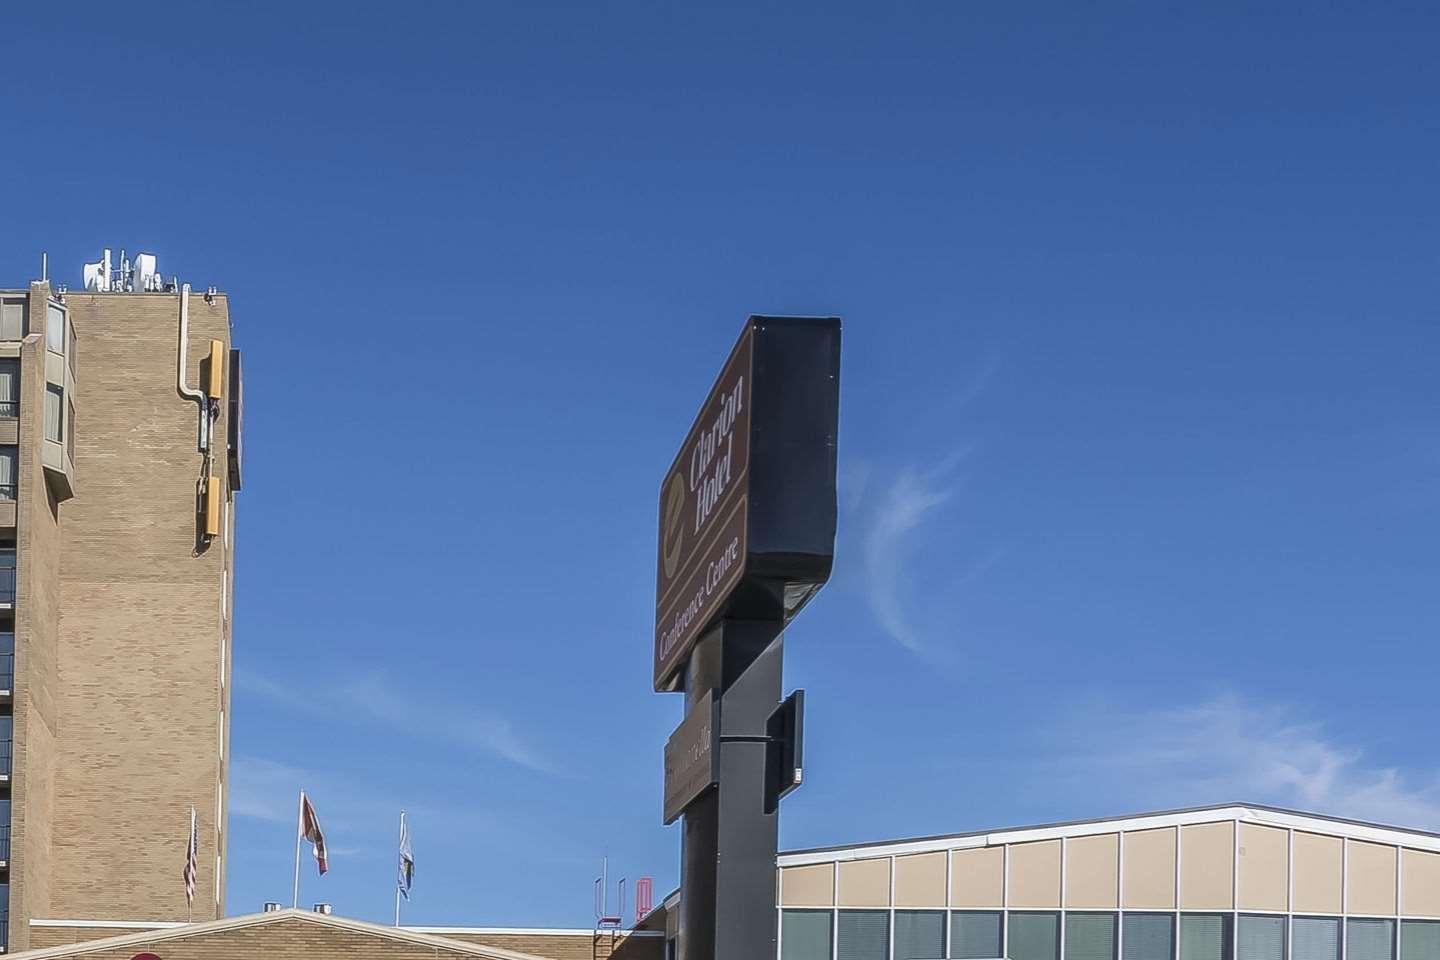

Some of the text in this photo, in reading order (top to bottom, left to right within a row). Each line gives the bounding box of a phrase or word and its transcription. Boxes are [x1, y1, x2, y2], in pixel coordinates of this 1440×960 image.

[690, 375, 743, 492] Clarion
[693, 431, 734, 537] Hotel
[659, 536, 739, 661] Conference Centre
